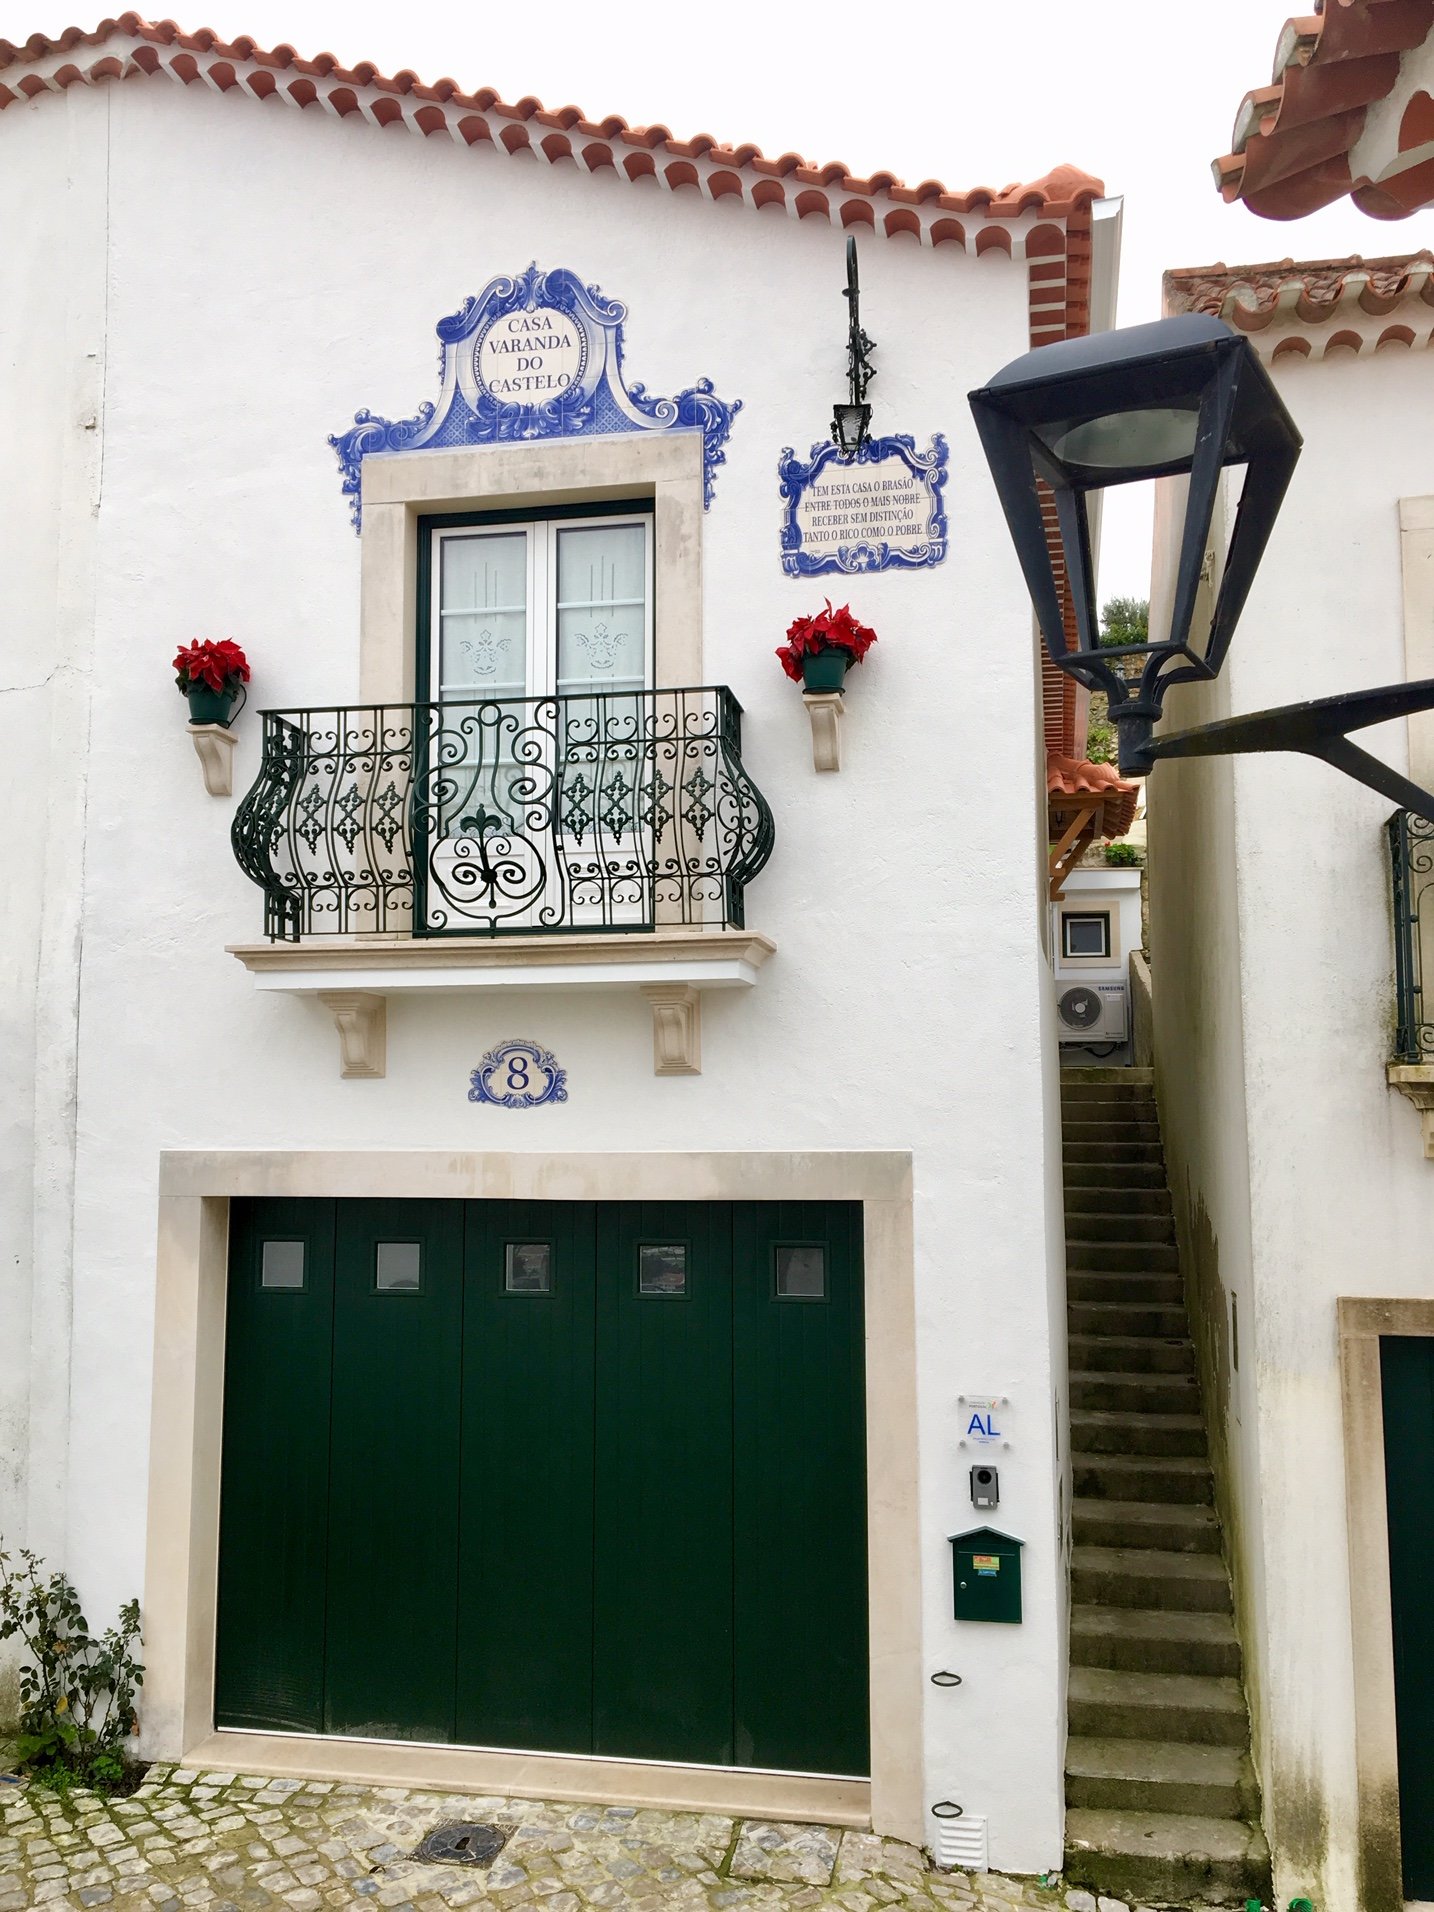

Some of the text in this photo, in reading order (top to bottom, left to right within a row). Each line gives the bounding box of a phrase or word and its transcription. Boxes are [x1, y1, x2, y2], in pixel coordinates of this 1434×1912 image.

[508, 316, 553, 333] CASA
[488, 334, 572, 354] VARANDA
[516, 356, 543, 372] DO
[489, 373, 571, 394] CASTELO
[812, 485, 829, 497] TEM
[831, 483, 851, 495] ESTA
[852, 481, 873, 494] CASA
[874, 481, 880, 491] O
[804, 493, 921, 513] ENTRE TODOS O MAIS NOBRE
[811, 514, 849, 527] RECEBER
[850, 512, 868, 524] SEM
[803, 523, 923, 543] TANTO O RICO COMO O POBRE
[506, 1056, 530, 1090] 8
[967, 1413, 1001, 1436] AL
